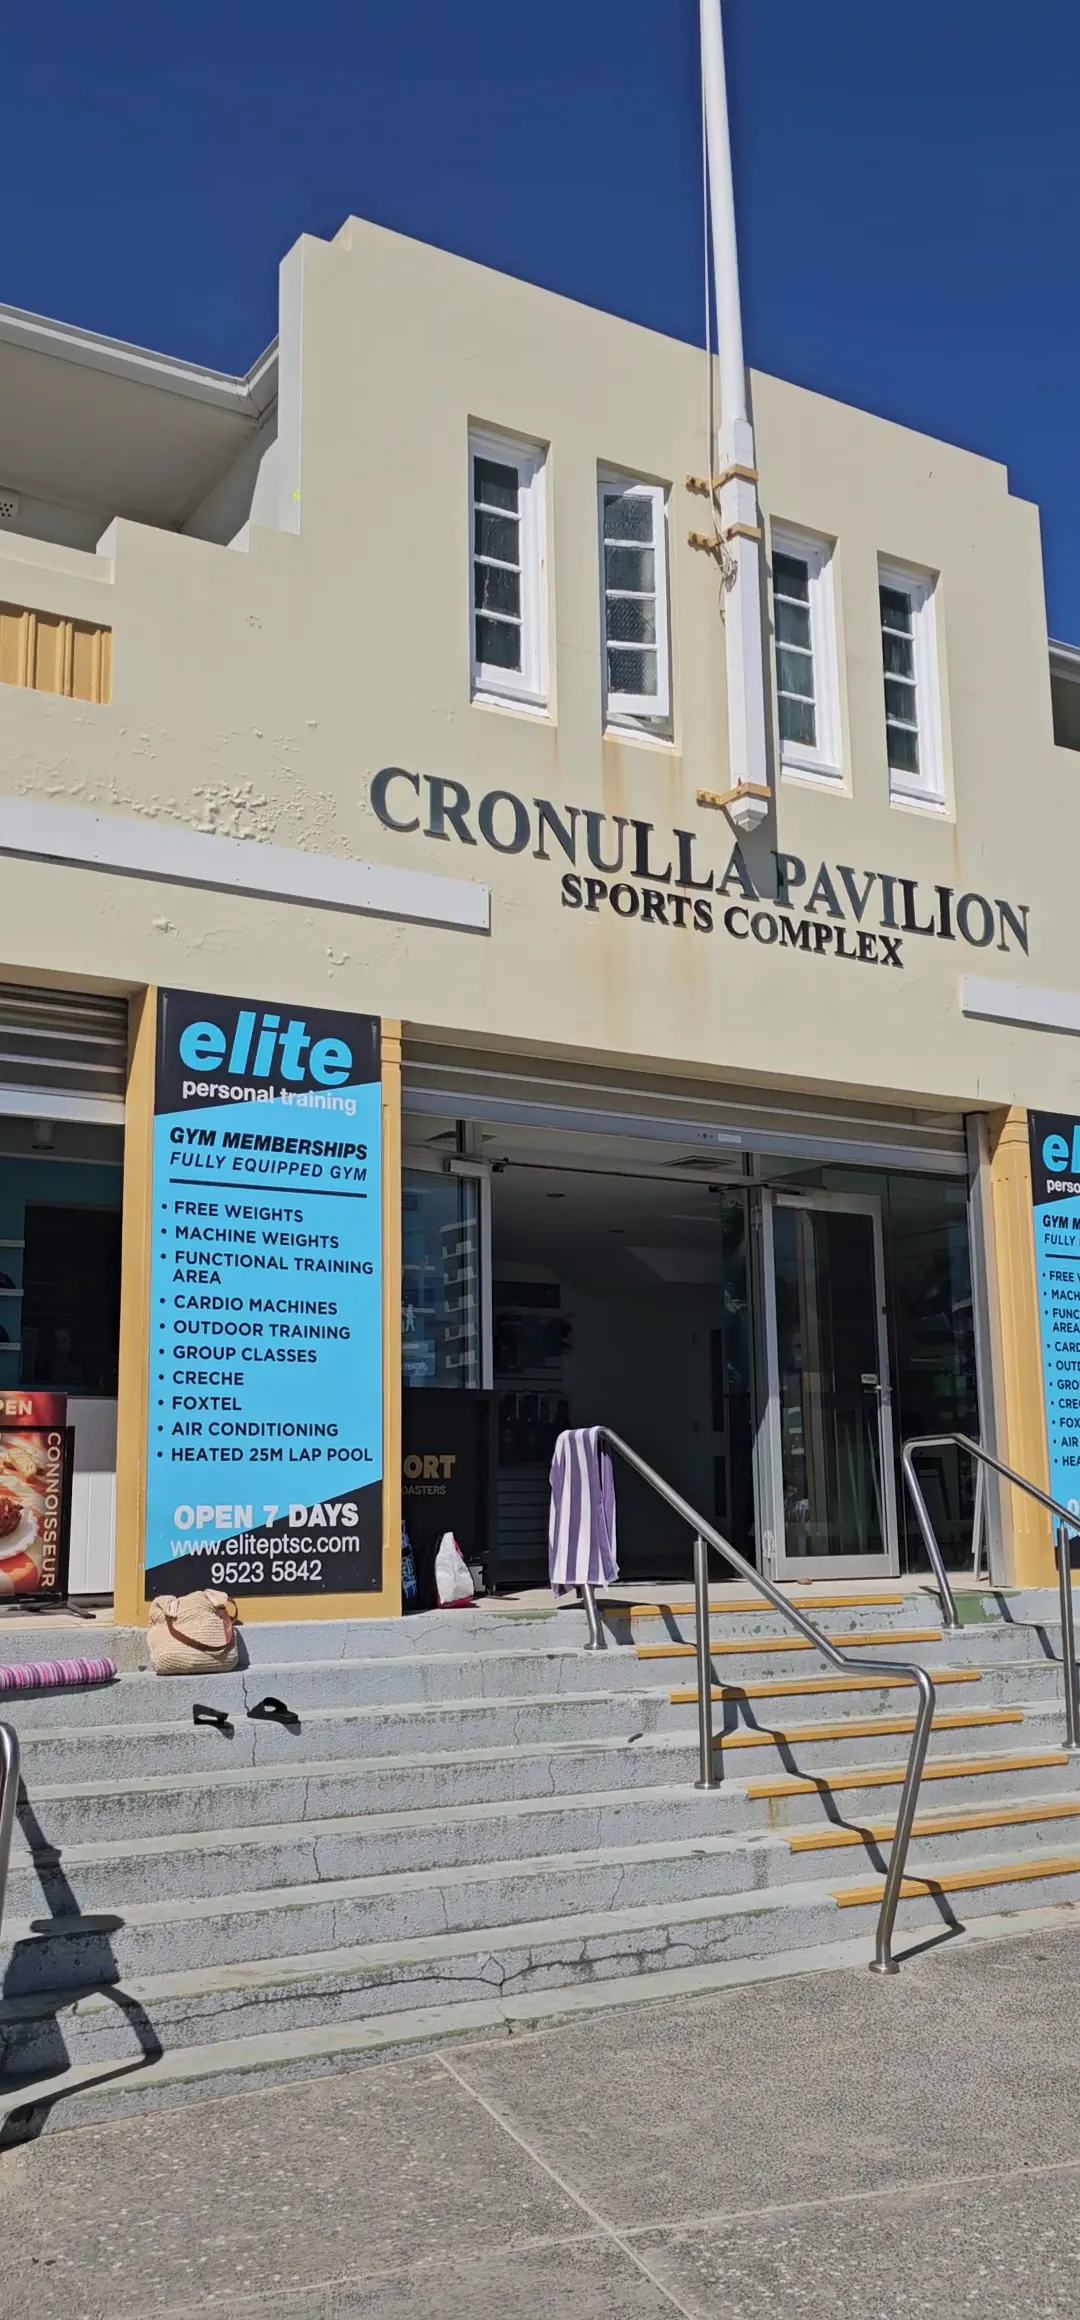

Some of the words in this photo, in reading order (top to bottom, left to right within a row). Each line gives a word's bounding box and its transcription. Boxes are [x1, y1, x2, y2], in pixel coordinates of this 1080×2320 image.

[370, 766, 760, 901] CRONULLA
[770, 850, 1031, 957] PAVILION
[560, 872, 713, 932] SPORTS
[724, 906, 904, 968] COMPLEX
[179, 1010, 352, 1086] elite
[182, 1080, 274, 1104] personal
[280, 1090, 356, 1116] training
[170, 1127, 216, 1146] GYM
[222, 1132, 368, 1160] MEMBERSHIPS
[170, 1152, 226, 1169] FULLY
[232, 1157, 323, 1178] EQUIPPED
[330, 1166, 367, 1182] GYM
[1046, 1179, 1080, 1194] perso
[174, 1201, 218, 1216] FREE
[224, 1204, 304, 1222] WEIGHTS
[1042, 1214, 1069, 1229] GYM
[176, 1226, 256, 1244] MACHINE
[262, 1232, 339, 1248] WEIGHTS
[1044, 1233, 1076, 1246] FULLY
[175, 1251, 288, 1270] FUNCTIONAL
[294, 1258, 374, 1274] TRAINING
[172, 1269, 221, 1284] AREA
[1049, 1270, 1075, 1282] FREE
[174, 1295, 243, 1311] CARDIO
[250, 1299, 338, 1315] MACHINES
[173, 1320, 264, 1337] OUTDOOR
[269, 1324, 351, 1340] TRAINING
[173, 1345, 236, 1361] GROUP
[241, 1348, 317, 1363] CLASSES
[173, 1371, 244, 1386] CRECHE
[1057, 1379, 1080, 1391] GRO
[172, 1396, 242, 1411] FOXTEL
[1058, 1398, 1080, 1409] CRE
[172, 1422, 202, 1436] AIR
[208, 1422, 338, 1437] CONDITIONING
[1061, 1437, 1079, 1447] AIR
[171, 1448, 243, 1462] HEATED
[249, 1448, 283, 1462] 25M
[289, 1448, 322, 1462] LAP
[327, 1448, 373, 1462] POOL
[403, 1455, 456, 1479] ORT
[41, 1432, 61, 1587] CONNOISSEUR
[173, 1504, 252, 1530] OPEN
[263, 1505, 278, 1527] 7
[288, 1503, 359, 1528] DAYS
[170, 1534, 360, 1559] www.eliteptsc.com
[211, 1561, 264, 1585] 9523
[271, 1559, 322, 1582] 5842
